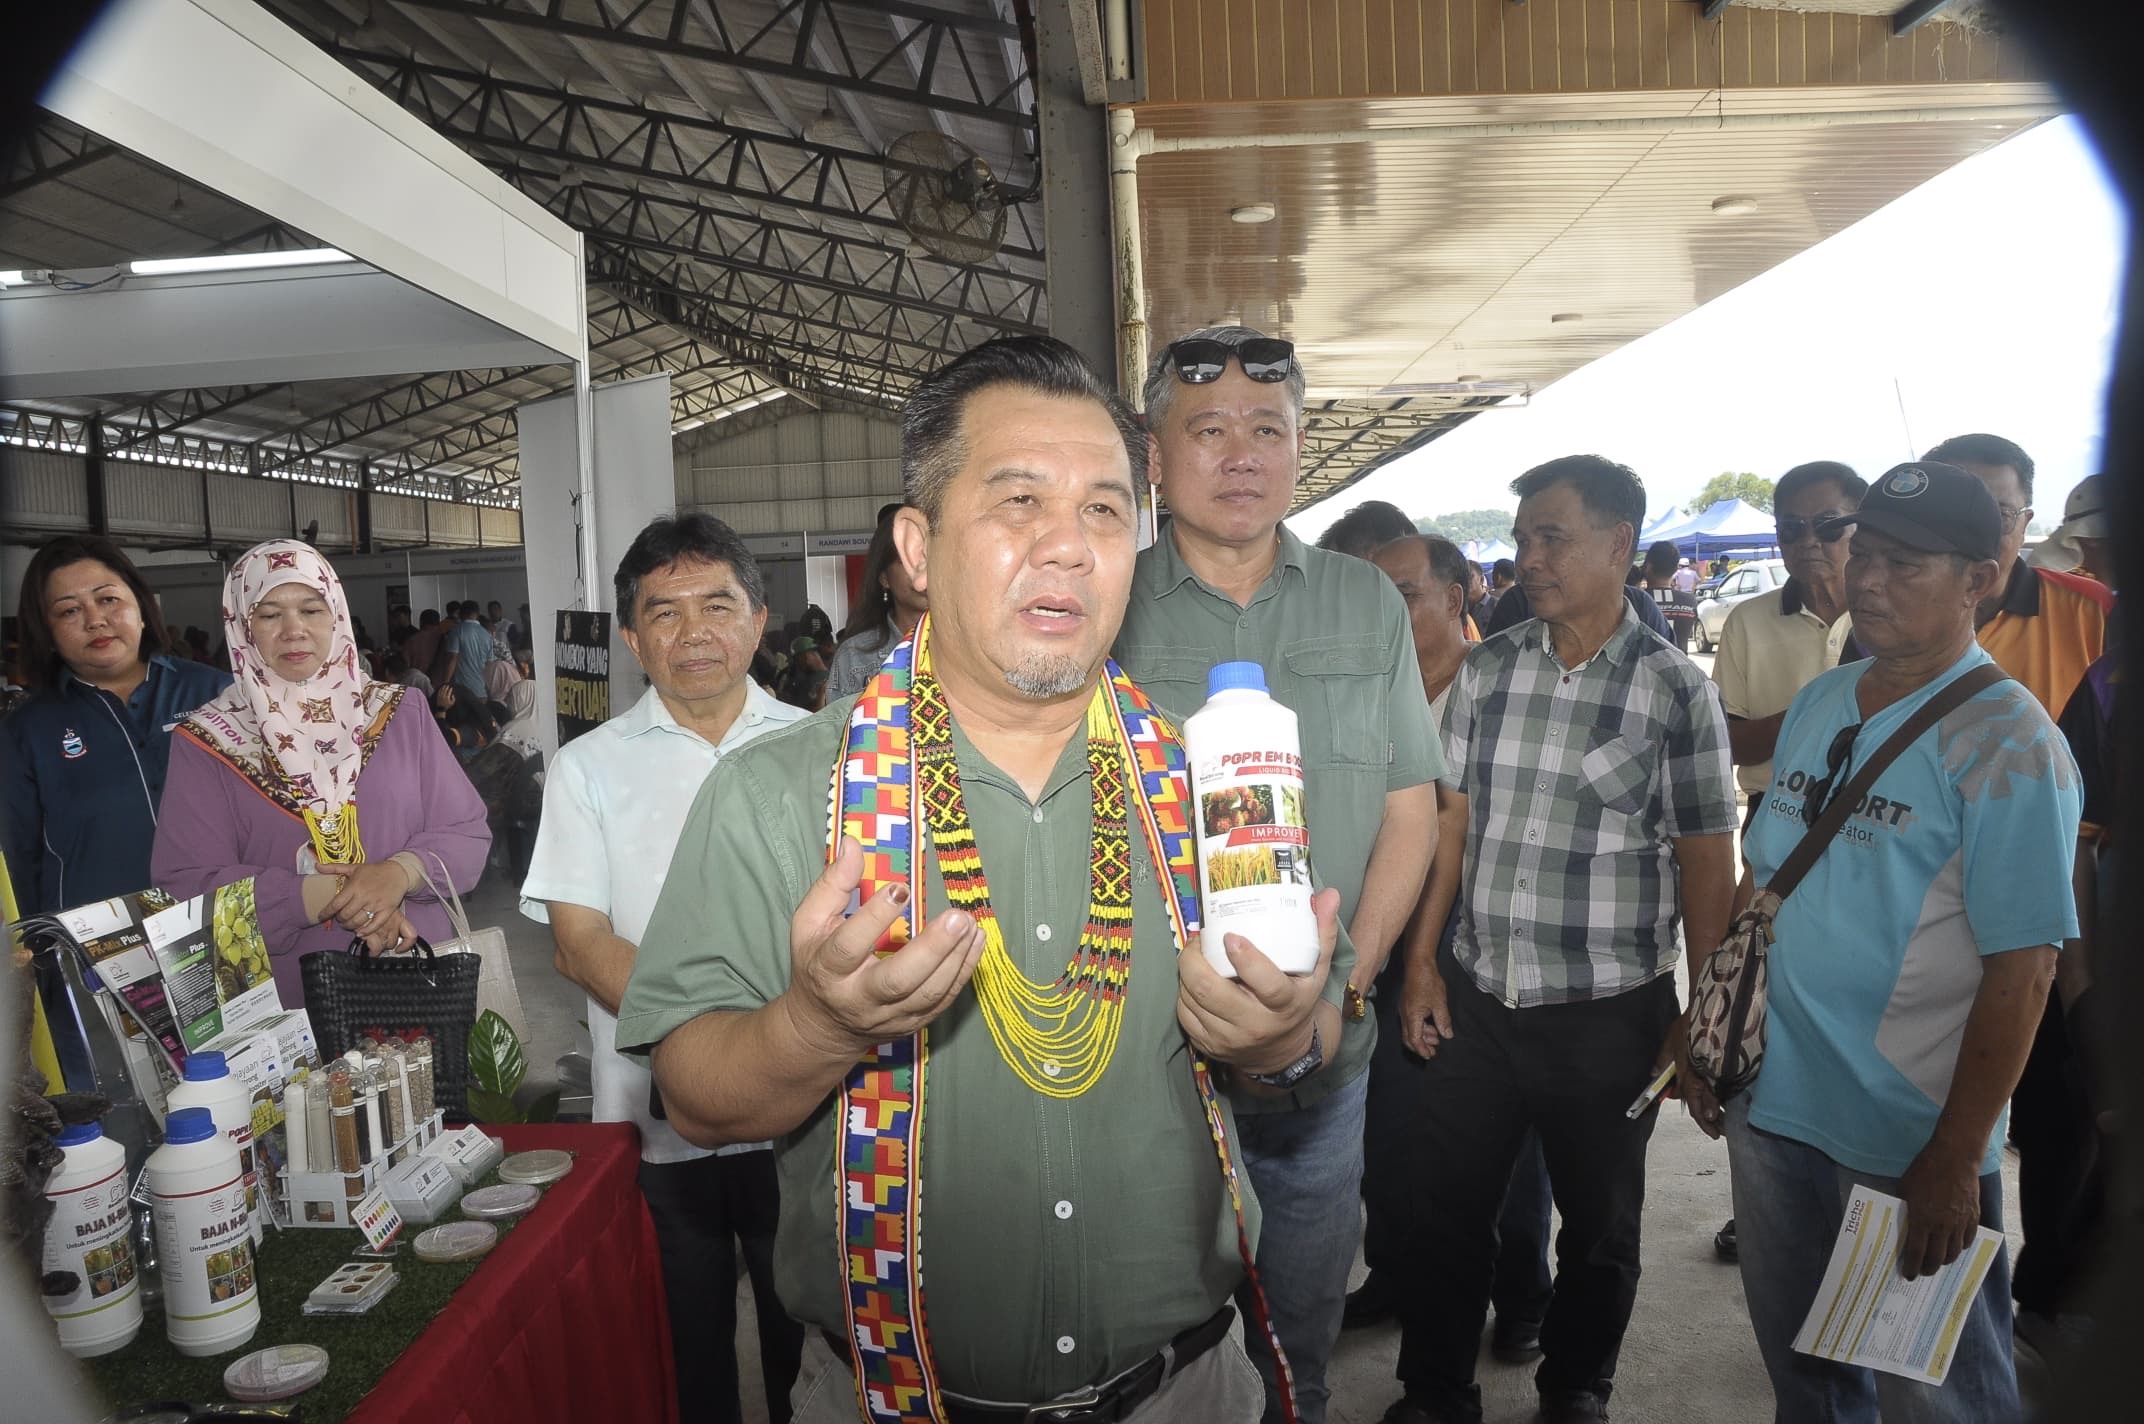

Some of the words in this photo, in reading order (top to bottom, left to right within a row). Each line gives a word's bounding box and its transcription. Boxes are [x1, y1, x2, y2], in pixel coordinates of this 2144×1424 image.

[586, 645, 608, 676] YANG
[1221, 750, 1262, 767] PGPR
[1264, 750, 1284, 763] EM
[1250, 827, 1300, 839] IMPROVE
[119, 933, 142, 947] Plus
[188, 941, 205, 955] Plus
[1844, 1199, 1861, 1233] Tricho
[75, 1217, 108, 1238] BAJA
[200, 1221, 230, 1241] BAJA
